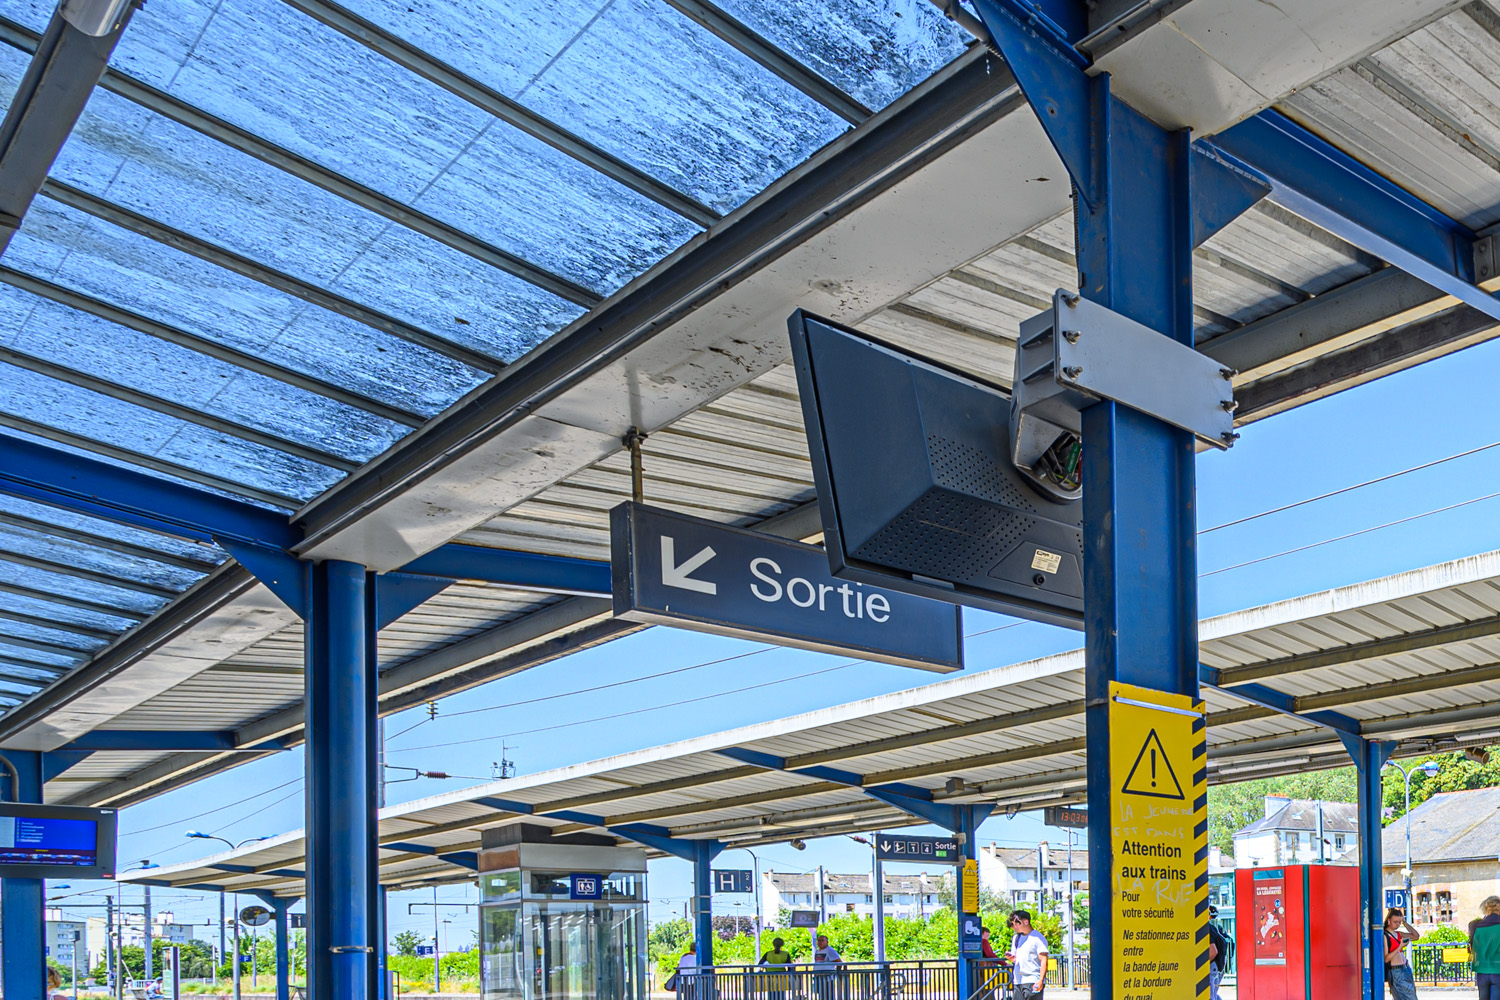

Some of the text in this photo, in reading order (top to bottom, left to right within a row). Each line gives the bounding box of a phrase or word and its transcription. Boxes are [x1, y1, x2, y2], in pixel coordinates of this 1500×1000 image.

[749, 557, 891, 623] Sortie
[1119, 800, 1134, 822] LA
[1113, 826, 1184, 839] EST DANS
[935, 841, 957, 851] Sortie
[1121, 840, 1182, 858] Attention
[1121, 865, 1187, 880] aux trains
[720, 874, 735, 891] H
[1122, 891, 1140, 902] Pour
[1151, 877, 1194, 905] RUE
[1395, 893, 1403, 907] D
[1122, 907, 1175, 918] votre sécurité
[1122, 930, 1190, 942] Ne stationnez pas
[1123, 946, 1144, 956] entre
[1123, 961, 1179, 973] la bande jaune
[1123, 977, 1172, 988] et la bordure
